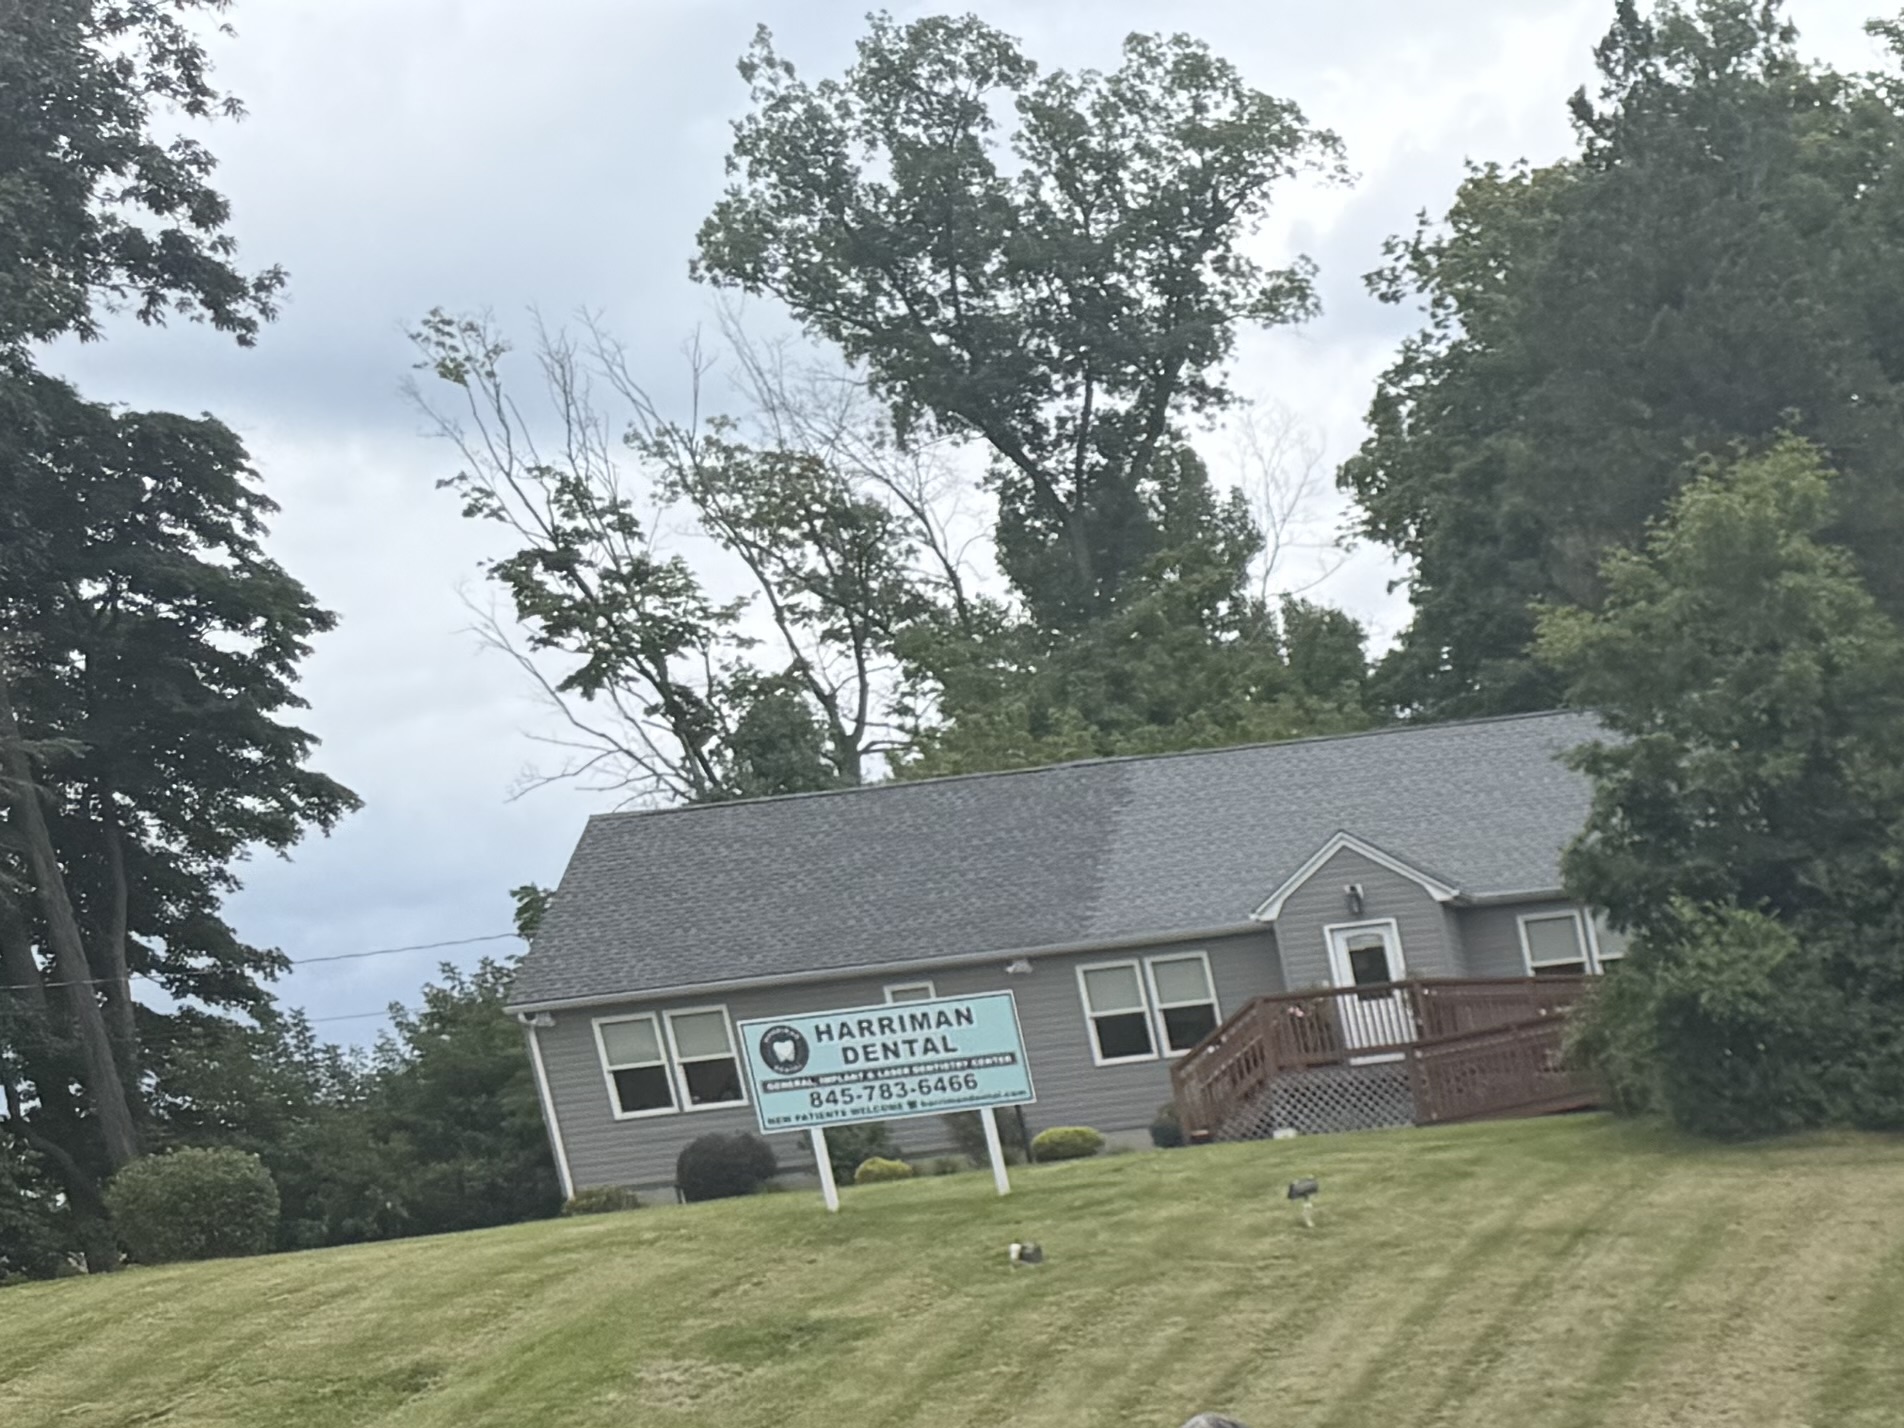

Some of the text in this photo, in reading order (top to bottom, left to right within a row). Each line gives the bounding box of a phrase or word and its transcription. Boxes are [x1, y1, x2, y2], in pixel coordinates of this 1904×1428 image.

[814, 1006, 975, 1043] HARRIMAN
[841, 1035, 958, 1065] DENTAL
[809, 1073, 978, 1109] 845-783-6466
[767, 1115, 792, 1125] NEW
[795, 1109, 847, 1122] PATIENTS
[850, 1103, 904, 1116] WELCOME
